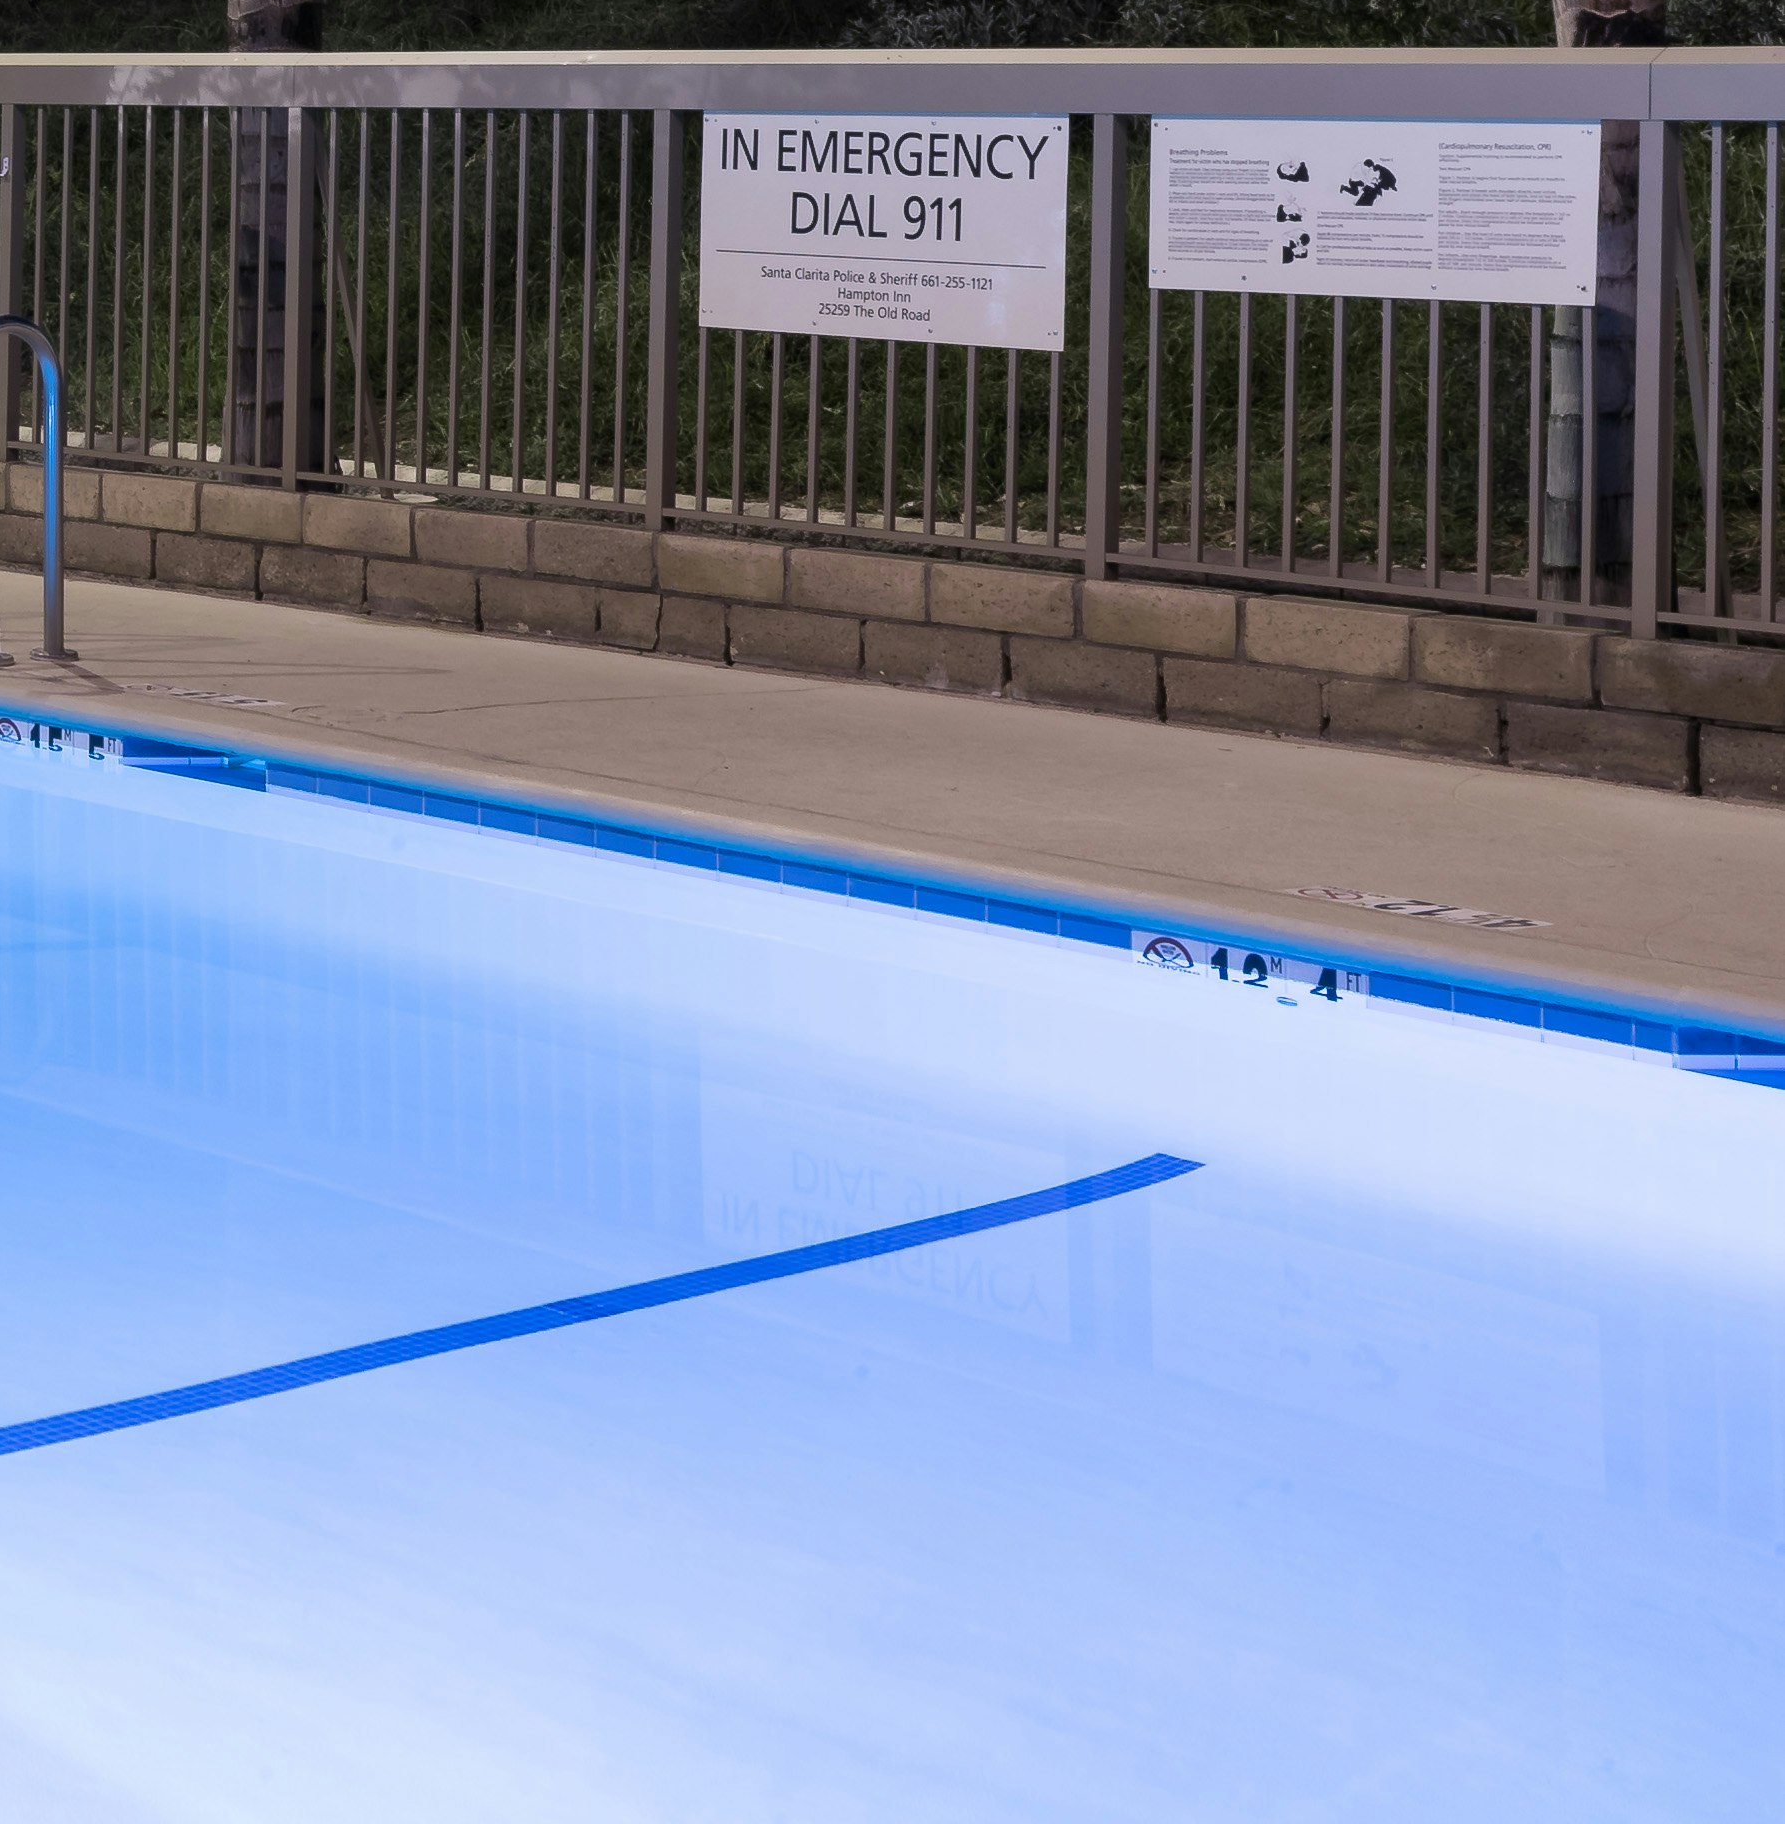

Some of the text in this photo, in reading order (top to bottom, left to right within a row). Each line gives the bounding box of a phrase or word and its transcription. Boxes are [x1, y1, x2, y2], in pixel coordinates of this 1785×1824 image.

[721, 128, 1049, 180] IN EMERGENCY
[791, 192, 962, 242] DIAL 911
[761, 266, 993, 290] Santa Clarita Police & Sheriff 661-255-1121
[838, 287, 911, 304] Hampton Inn
[819, 303, 930, 322] 25259 The Old Road
[64, 729, 72, 742] M
[89, 733, 105, 760] 5
[108, 738, 116, 753] FT
[1271, 957, 1283, 974] M
[1310, 968, 1343, 1002] 4
[1347, 974, 1362, 993] FT
